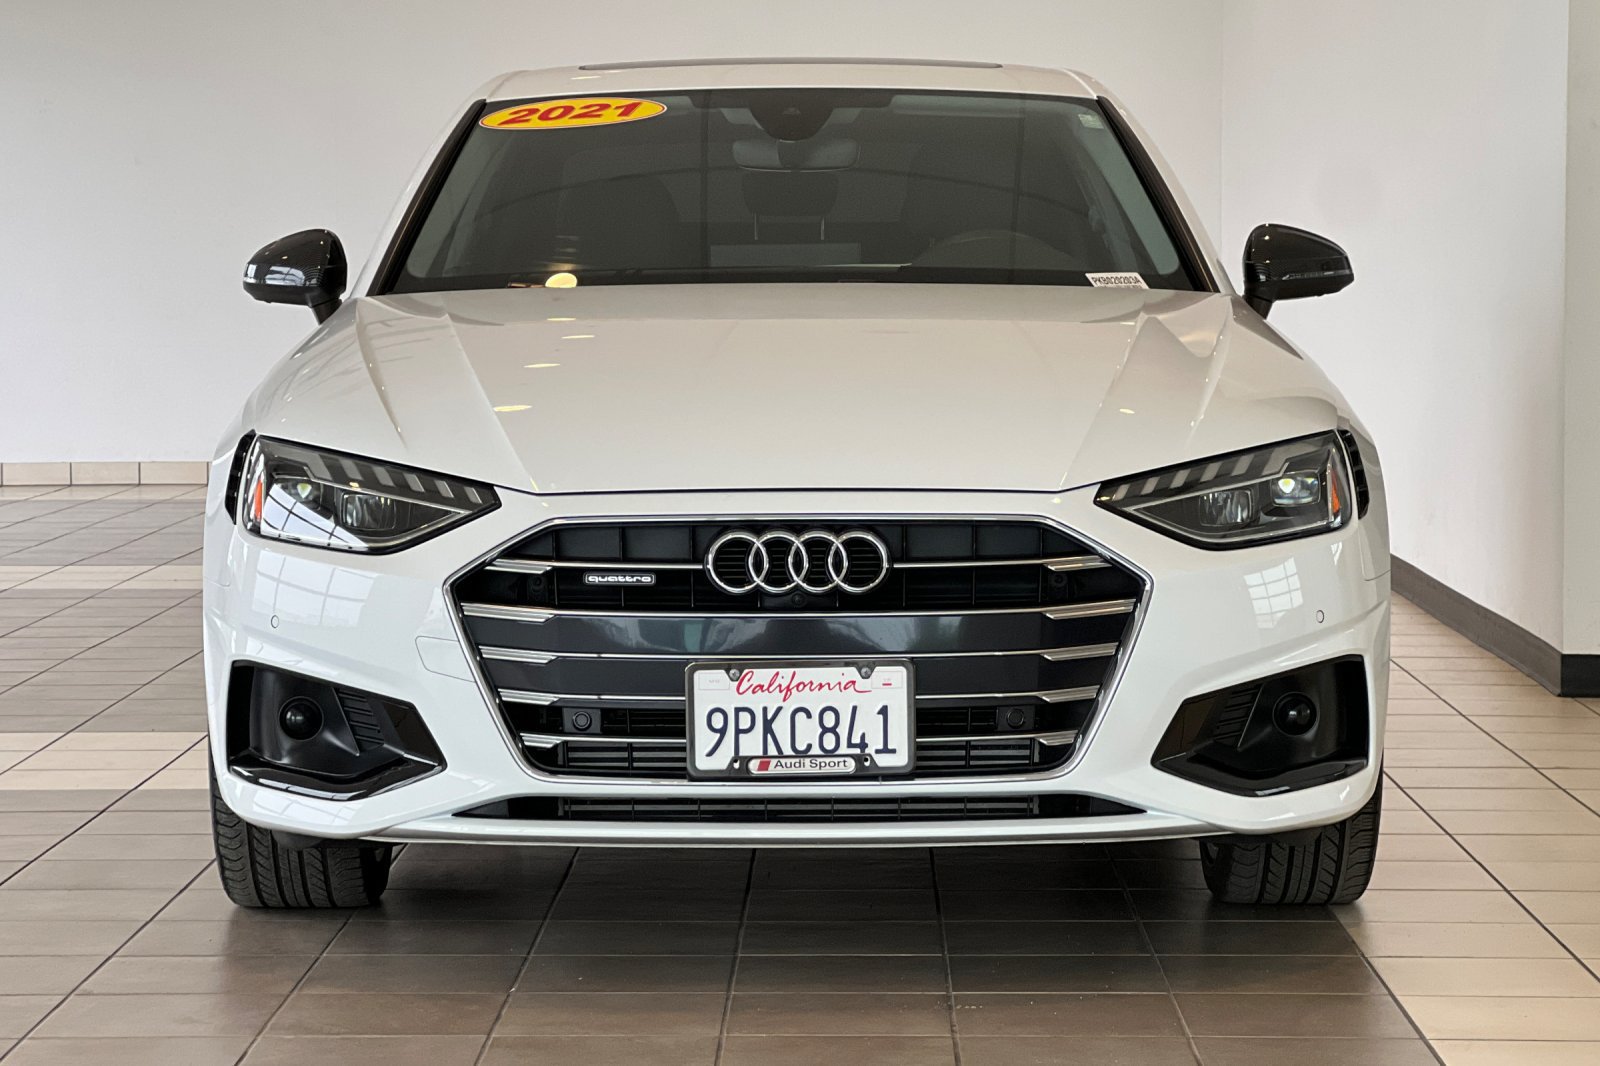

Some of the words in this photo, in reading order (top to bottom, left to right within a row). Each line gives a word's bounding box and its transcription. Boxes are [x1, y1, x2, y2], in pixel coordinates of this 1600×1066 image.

[497, 102, 642, 126] 2021
[588, 575, 651, 583] quattro
[736, 670, 872, 702] California
[705, 705, 897, 757] 9PKC841
[774, 759, 806, 769] Audi
[809, 759, 848, 770] Sport
